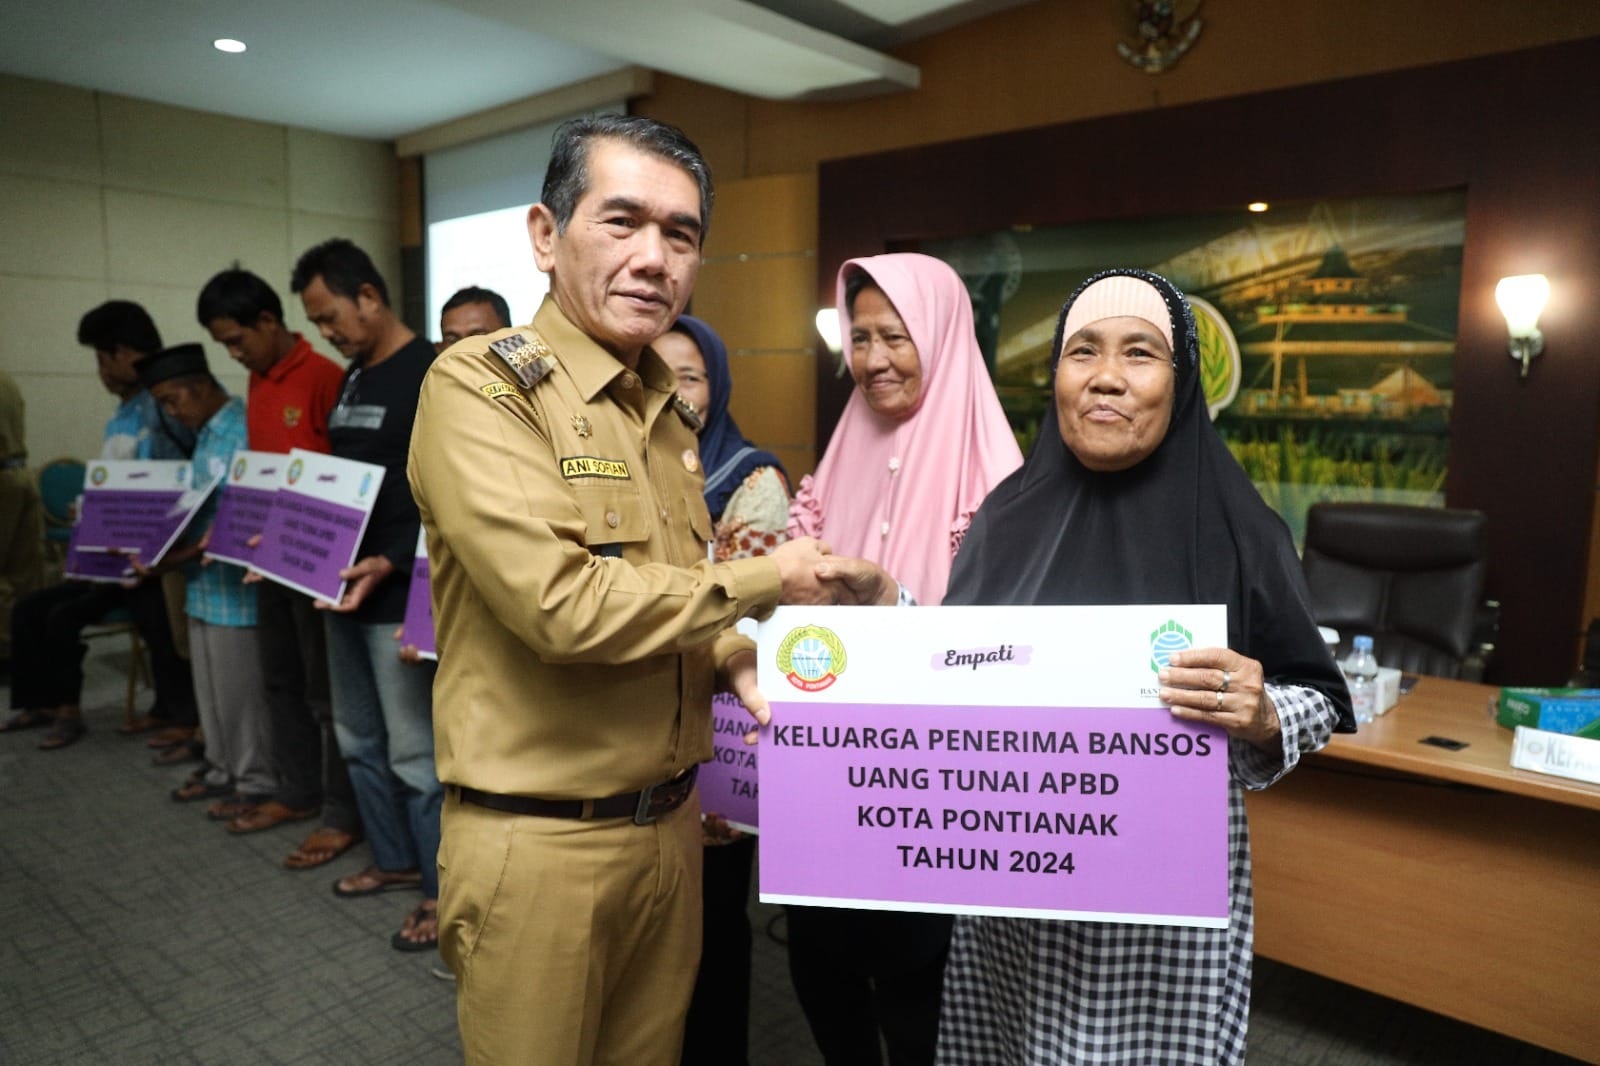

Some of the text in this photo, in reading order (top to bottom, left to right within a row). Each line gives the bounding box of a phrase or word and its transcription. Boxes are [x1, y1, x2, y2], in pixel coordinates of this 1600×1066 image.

[567, 460, 627, 475] ANI SOFIAN
[944, 645, 1015, 670] Empati
[772, 724, 1212, 757] KELUARGA PENERIMA BANSOS
[712, 745, 757, 769] KOTA
[848, 766, 1120, 796] UANG TUNAI APBD
[857, 805, 1119, 837] KOTA PONTIANAK
[896, 845, 1076, 875] TAHUN 2024
